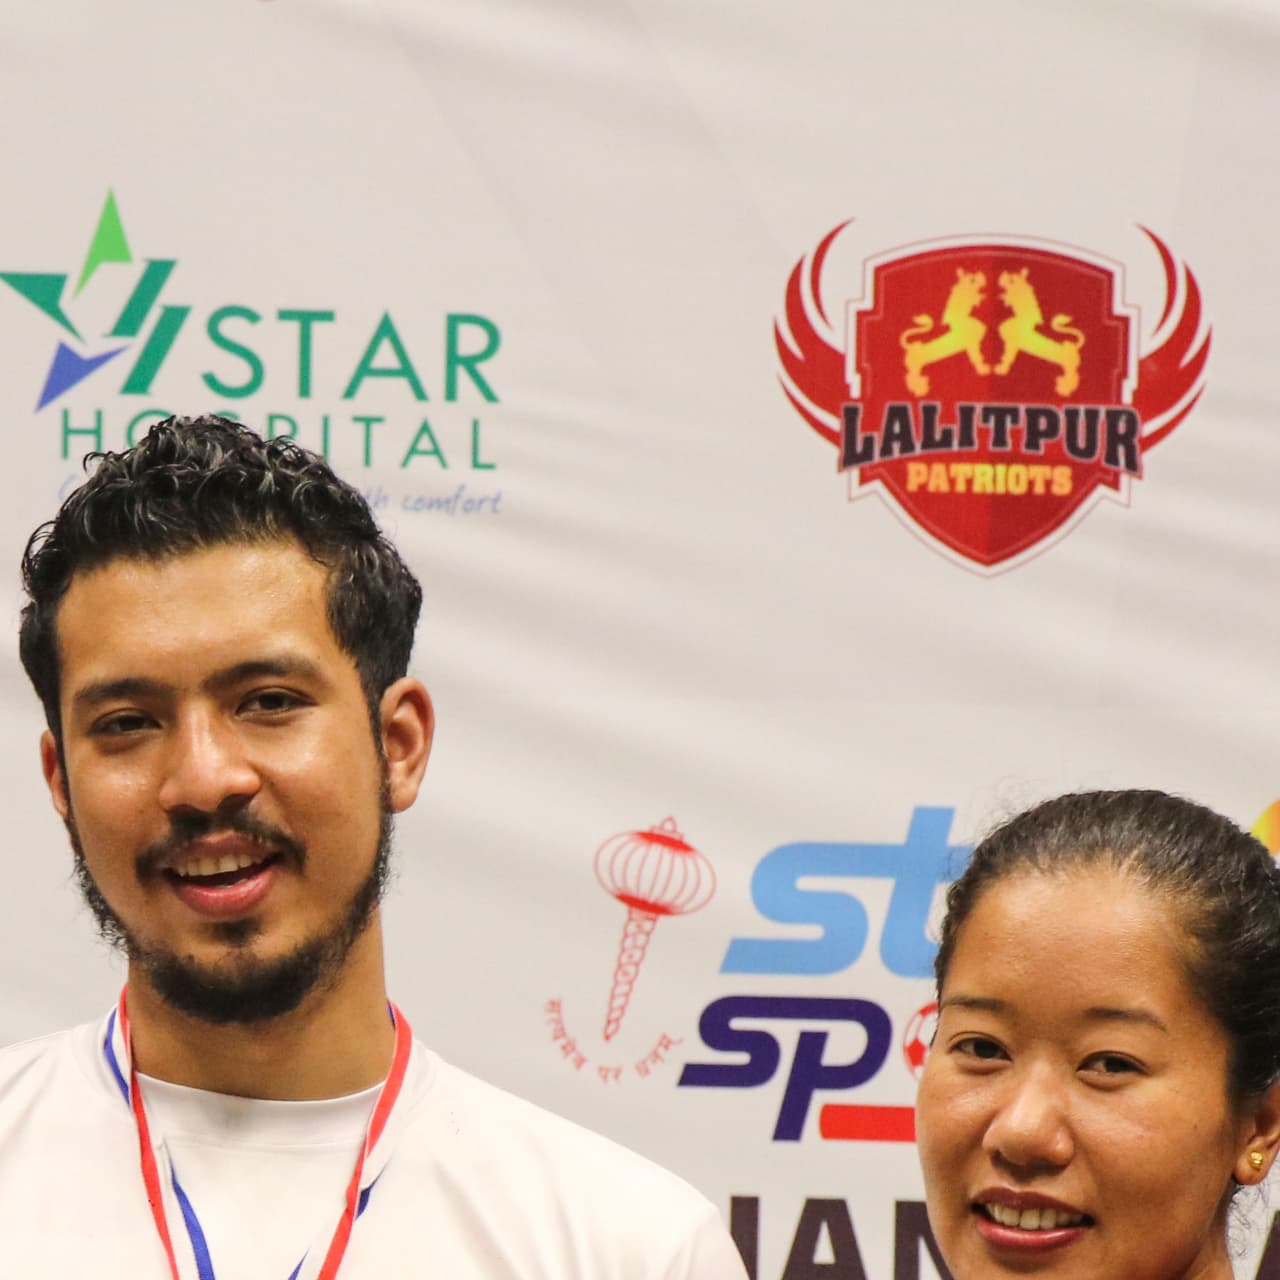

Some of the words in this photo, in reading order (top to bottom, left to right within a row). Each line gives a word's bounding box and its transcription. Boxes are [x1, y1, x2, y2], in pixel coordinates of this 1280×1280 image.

[201, 304, 503, 403] STAR
[838, 400, 1144, 481] LALITPUR
[906, 462, 1074, 497] PATRIOTS
